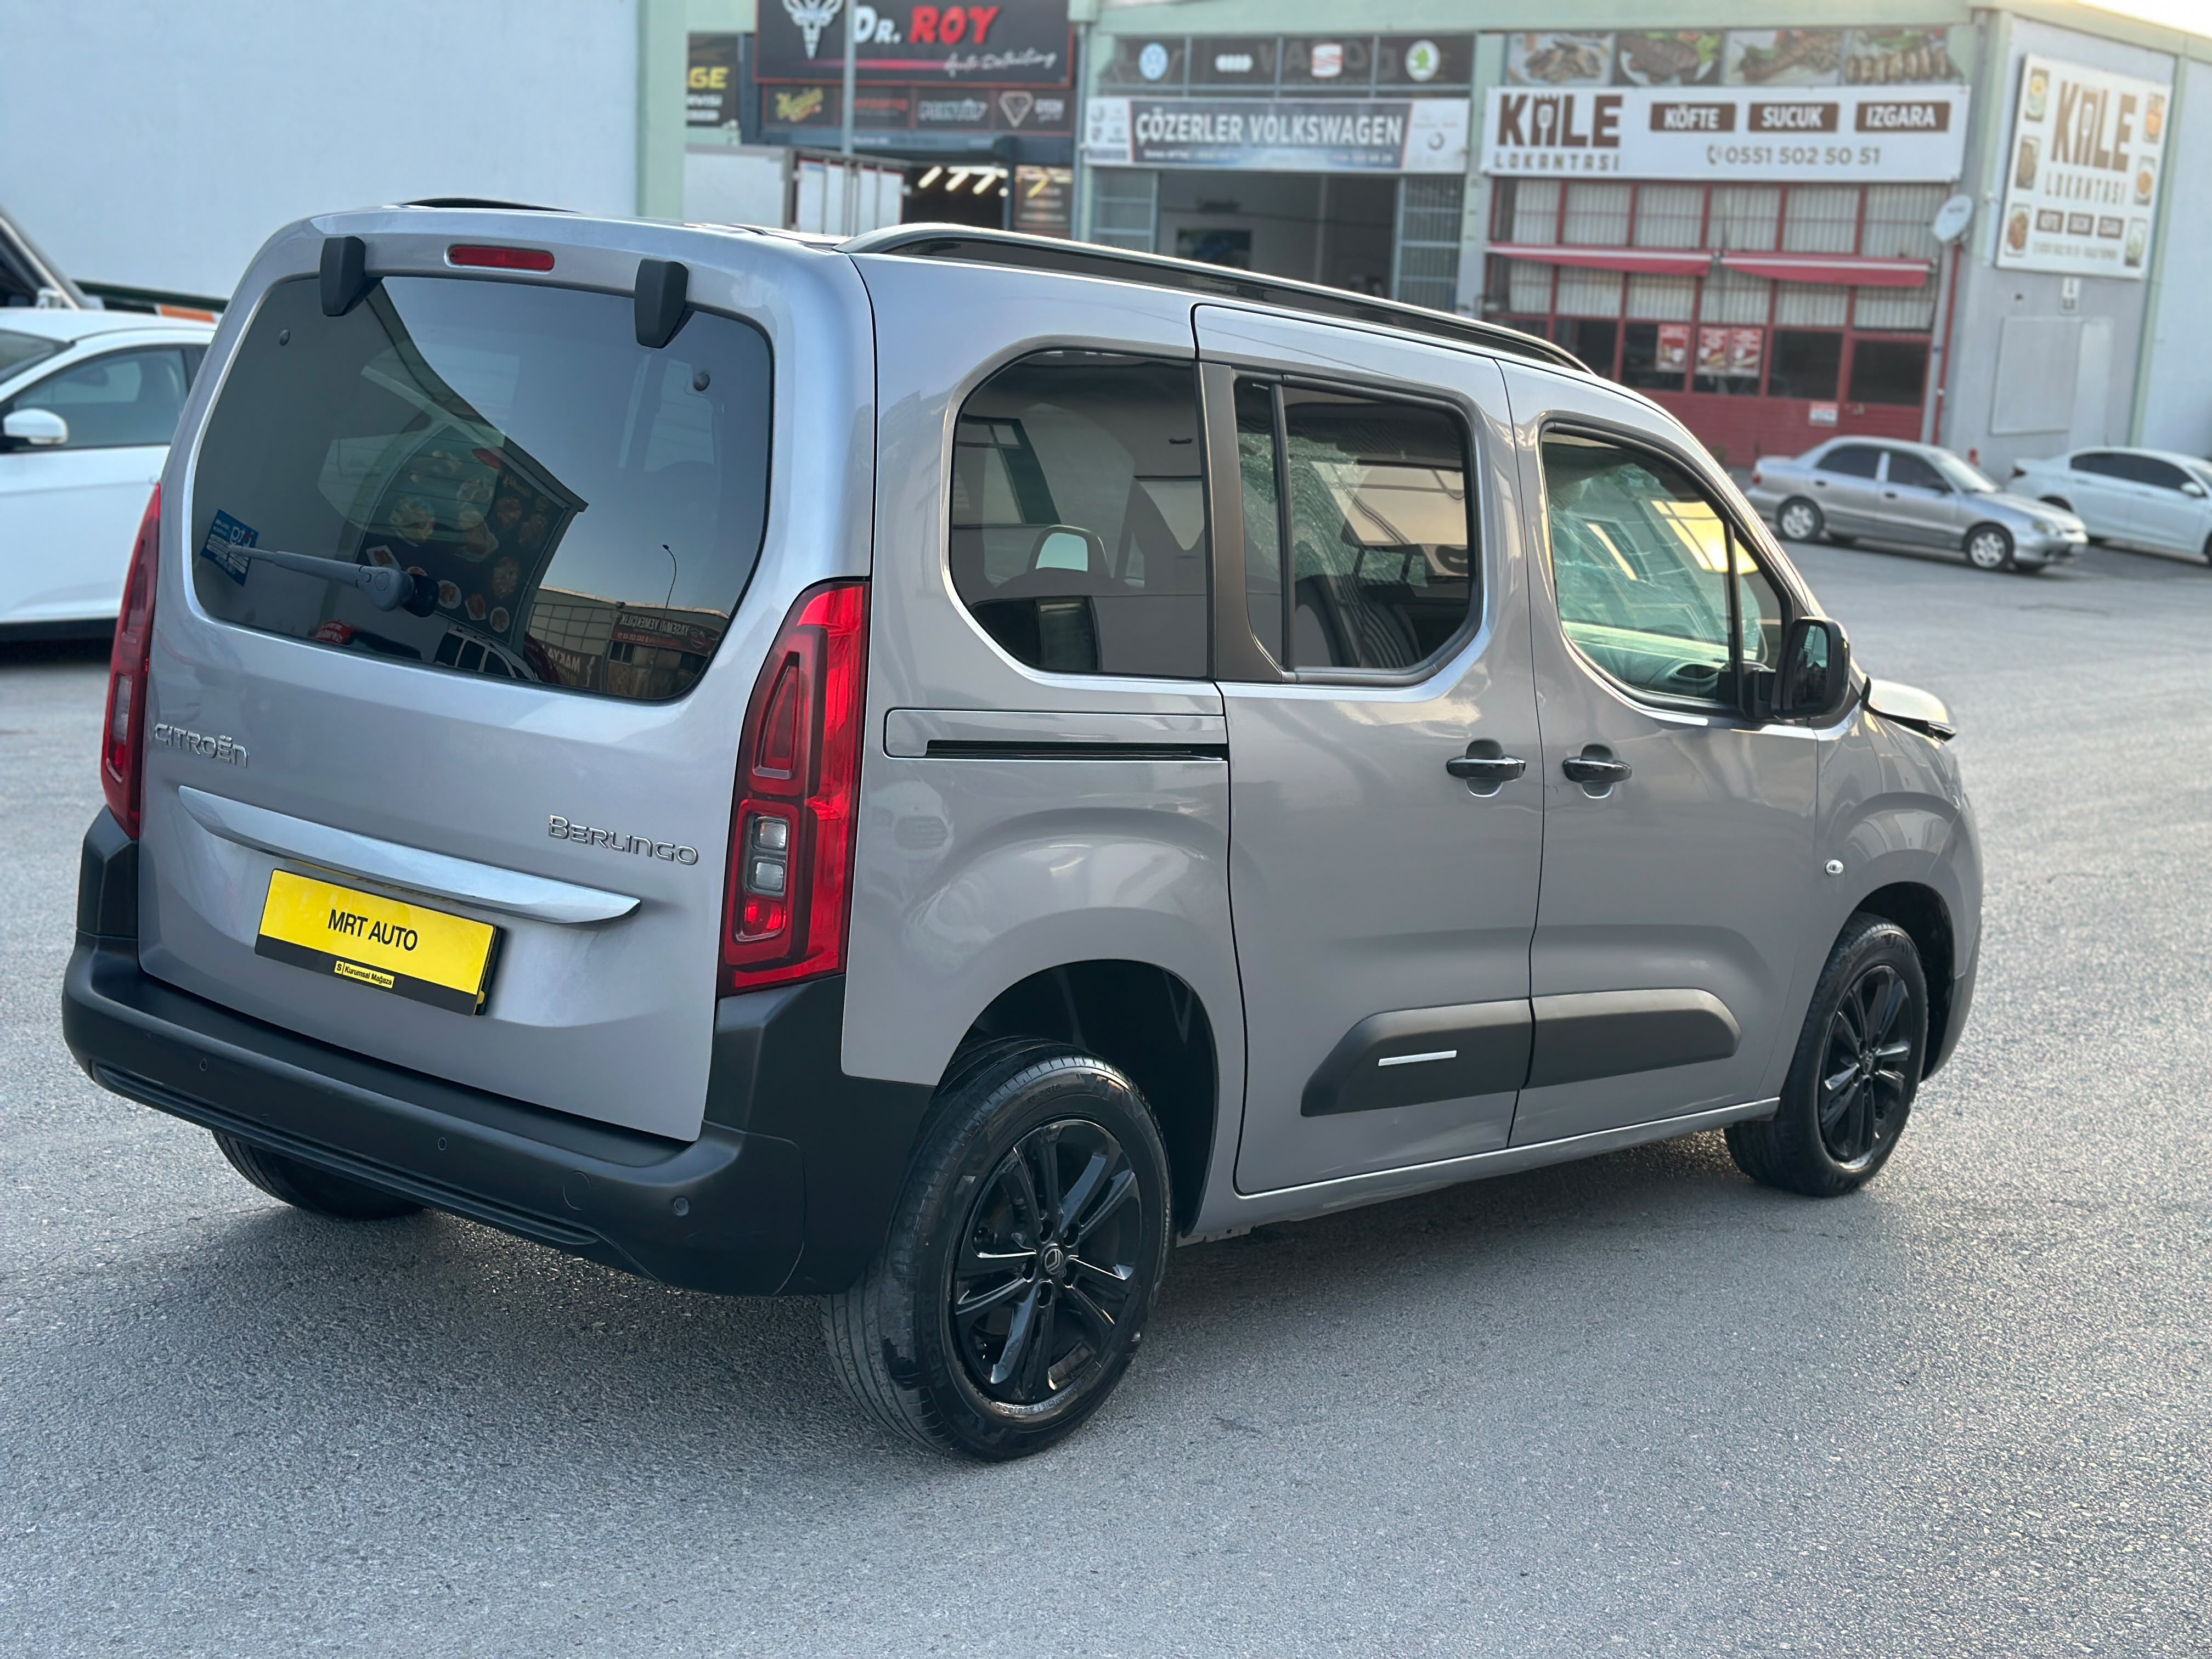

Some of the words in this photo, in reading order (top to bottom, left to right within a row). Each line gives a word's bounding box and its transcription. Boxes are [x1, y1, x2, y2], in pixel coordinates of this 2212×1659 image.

[909, 5, 1000, 44] ROY
[1136, 108, 1243, 146] ÇÖZERLER
[1249, 114, 1403, 145] VOLKSWAGEN
[1663, 103, 1719, 130] KÖFTE
[1761, 106, 1824, 128] SUCUK
[1866, 105, 1937, 128] IZGARA
[1725, 146, 1773, 165] 0551
[1779, 147, 1818, 166] 502
[1825, 147, 1853, 166] 50
[1859, 147, 1881, 166] 51
[328, 909, 368, 937] MRT
[368, 921, 418, 951] AUTO
[345, 966, 370, 979] Kurumsal
[371, 973, 392, 985] Mağaza
